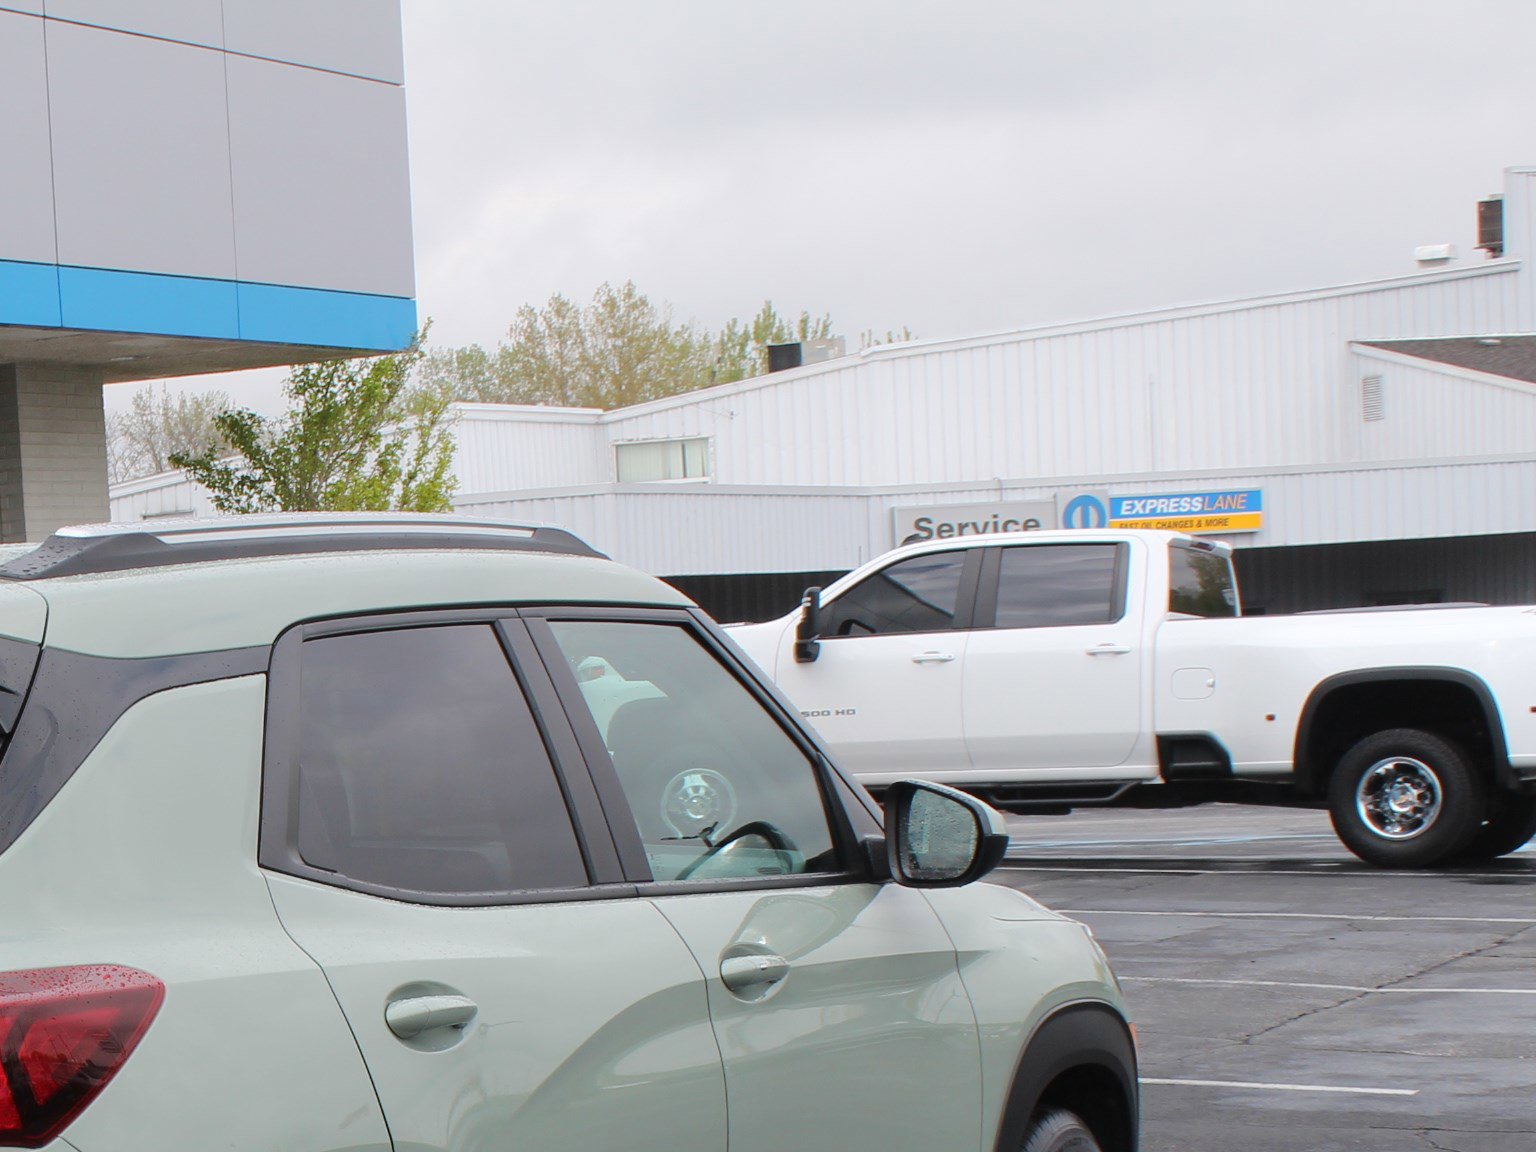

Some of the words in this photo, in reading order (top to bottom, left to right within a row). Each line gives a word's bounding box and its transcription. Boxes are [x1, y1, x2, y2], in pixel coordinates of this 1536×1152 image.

[914, 514, 1041, 540] Service
[1155, 519, 1194, 530] CHANGES
[1205, 518, 1230, 527] MORE
[835, 708, 856, 716] HD
